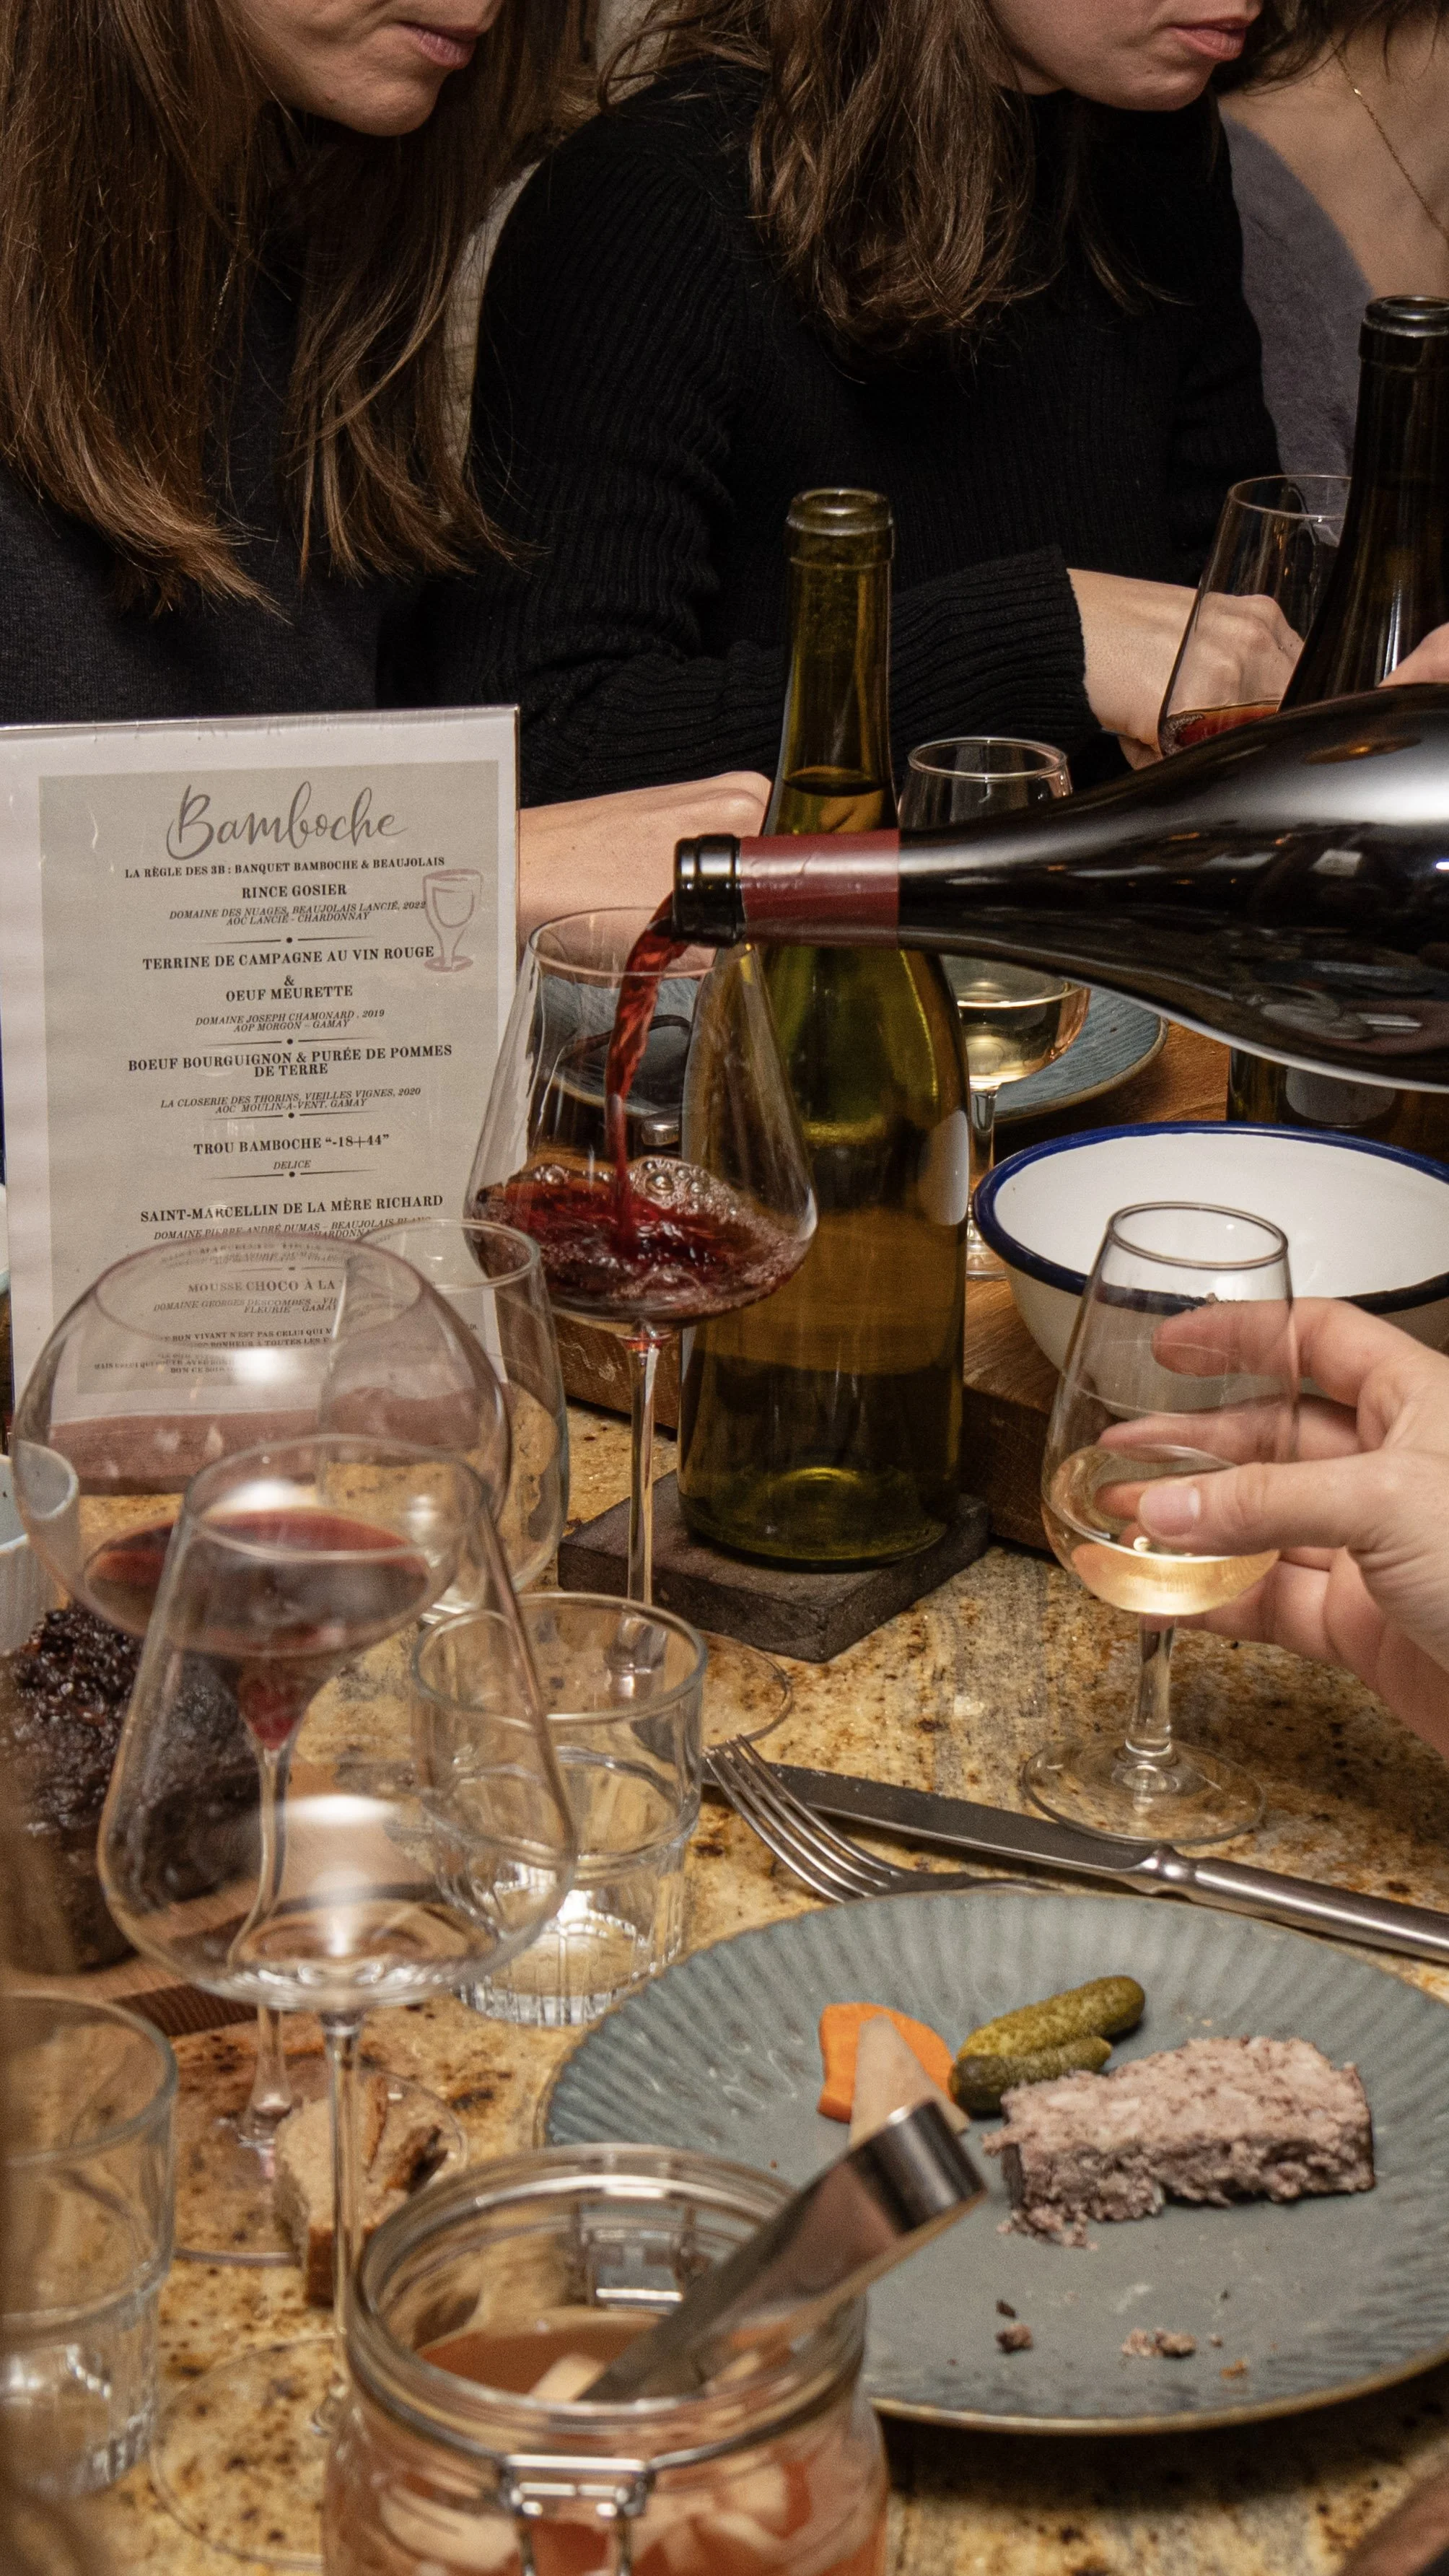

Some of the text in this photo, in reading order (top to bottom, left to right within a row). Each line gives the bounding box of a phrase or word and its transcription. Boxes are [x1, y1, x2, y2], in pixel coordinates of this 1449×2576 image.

[167, 781, 408, 860] Bamboche
[125, 869, 140, 878] LA
[144, 866, 182, 878] RÈGLE
[185, 866, 208, 876] DES
[211, 865, 225, 875] 3B
[235, 863, 290, 875] BANQUET
[294, 860, 359, 871] BAMBOCHE
[361, 860, 369, 869] &
[373, 857, 445, 869] BEAUJOLAIS
[242, 884, 347, 899] RINCE GOSIER
[170, 909, 219, 920] DOMAINE
[222, 907, 241, 918] DES
[244, 906, 289, 917] NUAGES,
[292, 904, 356, 914] BEAUJOLAIS
[403, 901, 426, 909] 2022
[226, 916, 247, 926] AOC
[297, 912, 370, 923] CHARDONNAY
[142, 946, 434, 970] TERRINE DE CAMPAGNE AU VIN ROUGE
[284, 974, 295, 987] &
[226, 985, 353, 1002] OEUF MEURETTE
[196, 1015, 244, 1026] DOMAINE
[246, 1013, 286, 1023] JOSEPH
[289, 1010, 355, 1021] CHAMONARD
[362, 1009, 385, 1018] 2019
[233, 1023, 255, 1033] AOP
[257, 1021, 302, 1031] MORGON
[312, 1018, 350, 1029] GAMAY
[128, 1044, 452, 1072] BOEUF BOURGUIGNON & PURÉE DE POMMES
[254, 1063, 328, 1078] DE TERRE
[160, 1099, 174, 1109] LA
[177, 1096, 228, 1107] CLOSERIE
[231, 1095, 250, 1105] DES
[305, 1090, 352, 1101] VIEILLES
[398, 1087, 421, 1096] 2020
[216, 1105, 236, 1114] AOC
[330, 1098, 367, 1108] GAMAY
[193, 1142, 235, 1155] TROU
[239, 1138, 322, 1153] BAMBOCHE
[273, 1160, 312, 1170] DELICE
[141, 1195, 443, 1223] SAINT-MARCELLIN DE LA MÈRE RICHARD
[154, 1228, 203, 1240] DOMAINE
[284, 1222, 320, 1233] DUMAS
[331, 1218, 394, 1231] BEAUJOLAIS
[188, 1278, 336, 1293] MOUSSE CHOCO À LA
[154, 1300, 201, 1312] DOMAINE
[244, 1305, 290, 1314] FLEURIE
